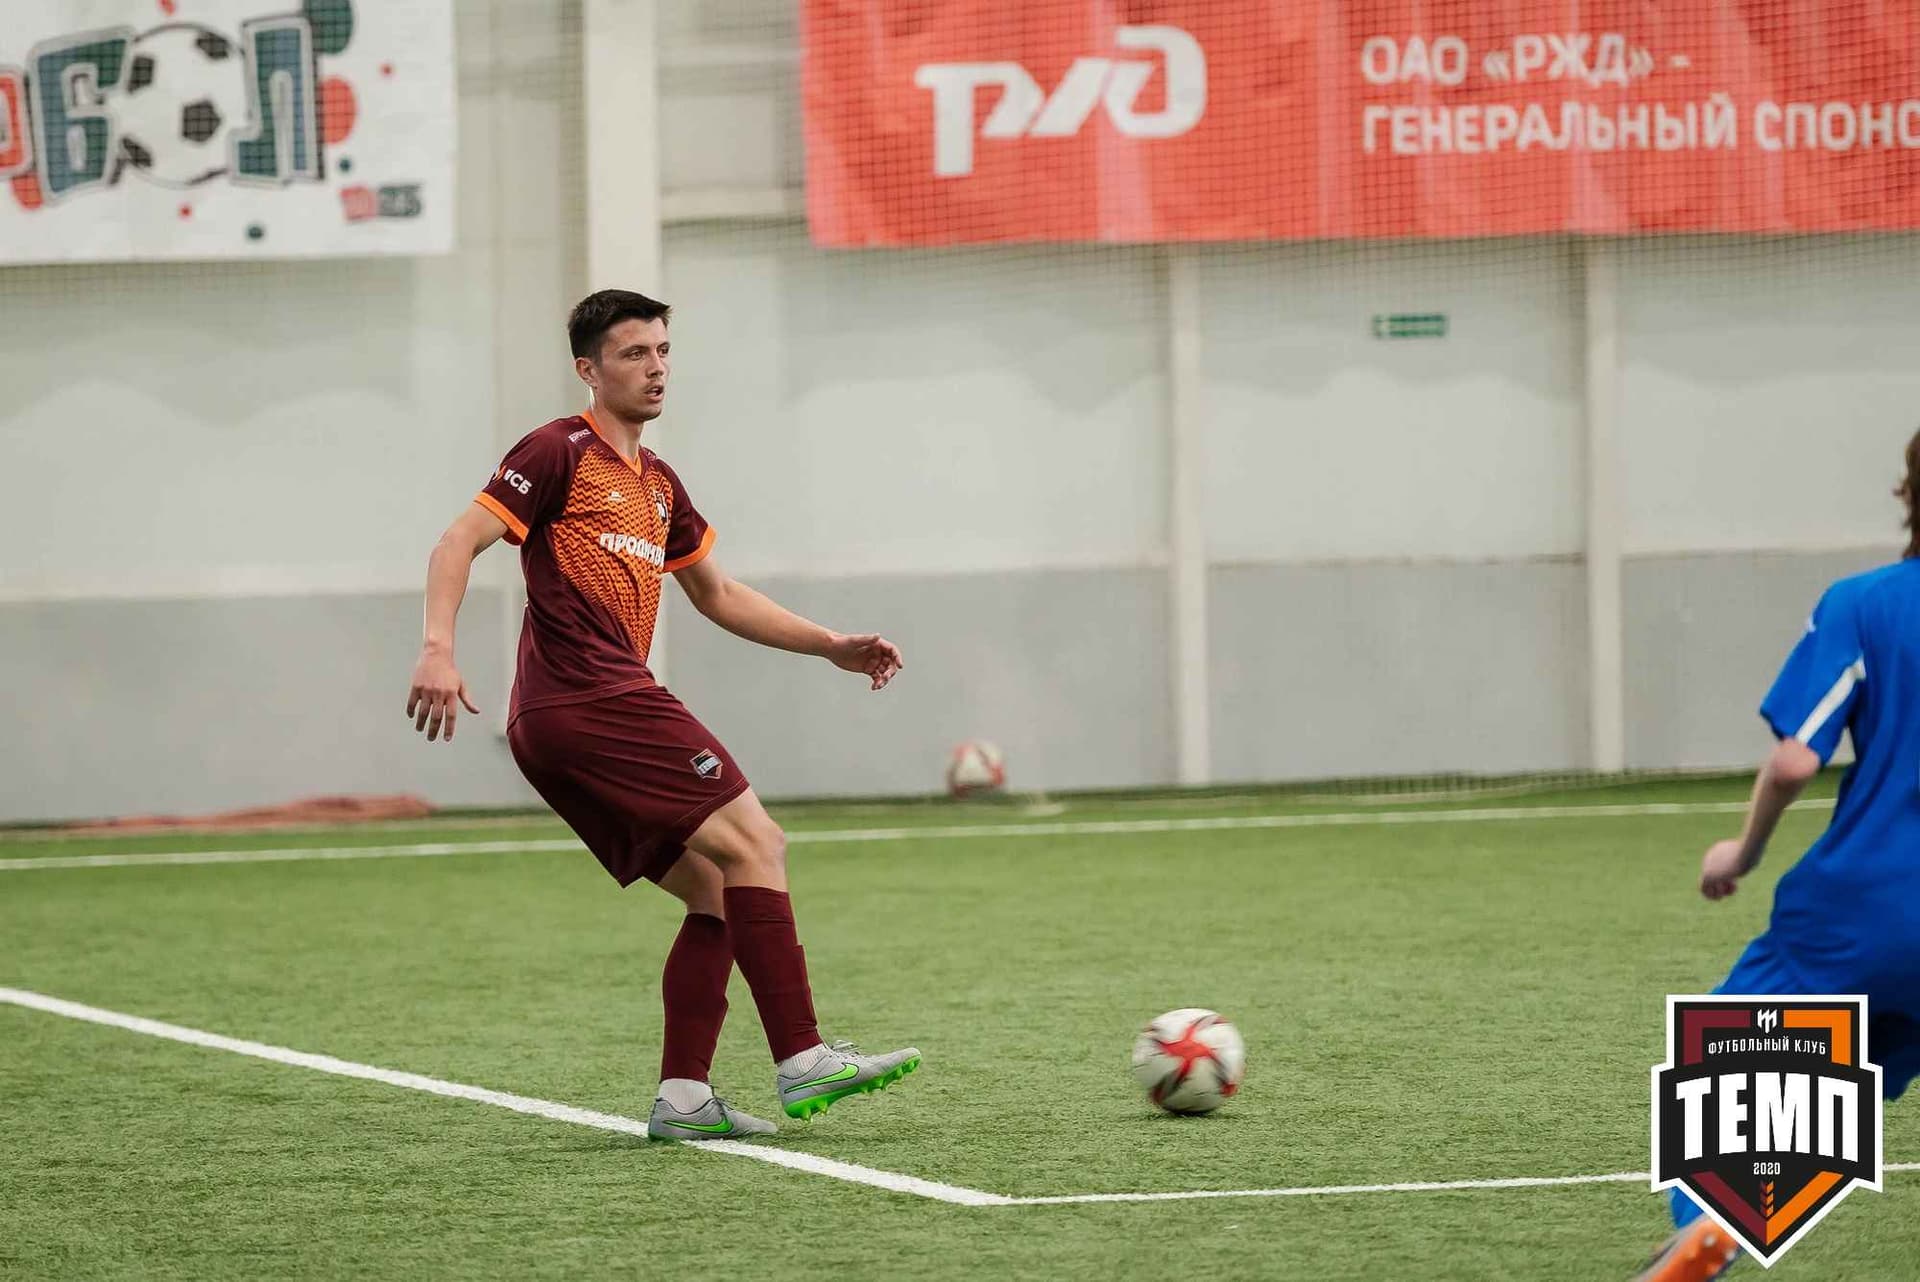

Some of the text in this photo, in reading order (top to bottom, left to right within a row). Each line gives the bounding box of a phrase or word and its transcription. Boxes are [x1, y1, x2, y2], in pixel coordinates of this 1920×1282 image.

[1361, 34, 1469, 86] ОАО
[1482, 32, 1654, 88] «РЖД»
[1363, 91, 1738, 156] ГЕНЕРАЛЬНЫЙ
